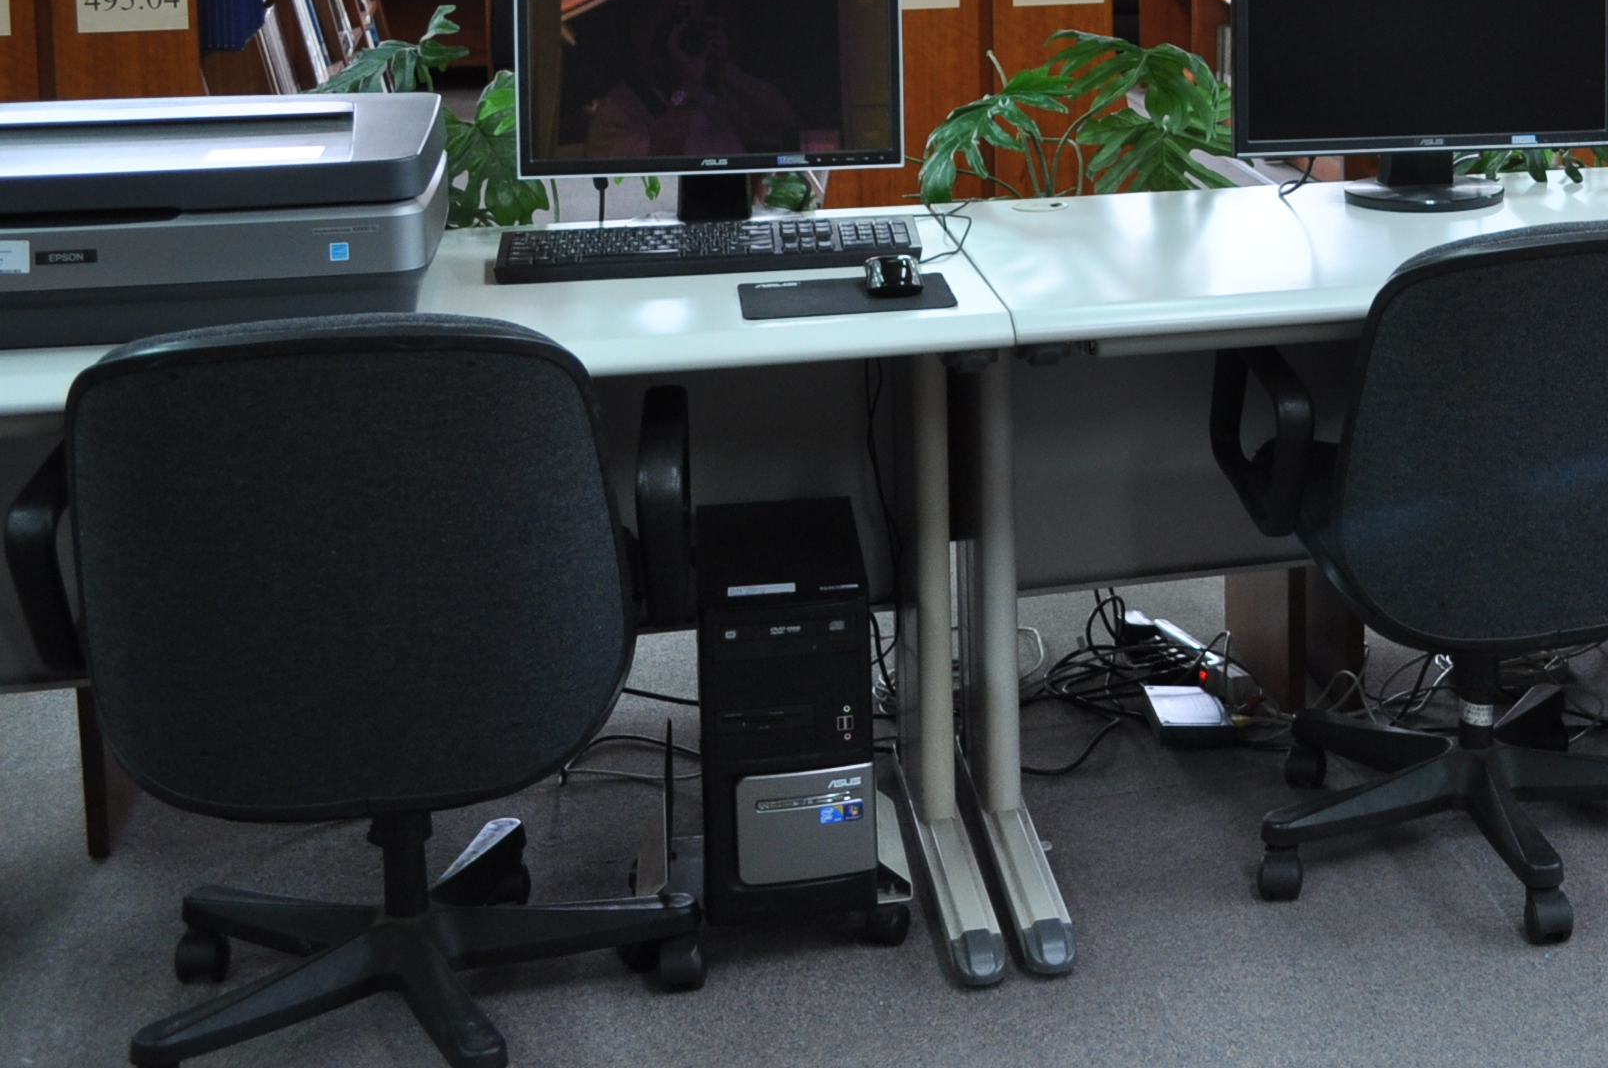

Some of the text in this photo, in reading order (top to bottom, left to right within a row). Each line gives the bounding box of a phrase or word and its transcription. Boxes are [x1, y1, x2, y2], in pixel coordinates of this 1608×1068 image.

[1420, 138, 1444, 146] ASUS
[701, 158, 728, 166] ASUS
[48, 252, 84, 263] EPSON
[827, 776, 862, 789] ASUS
